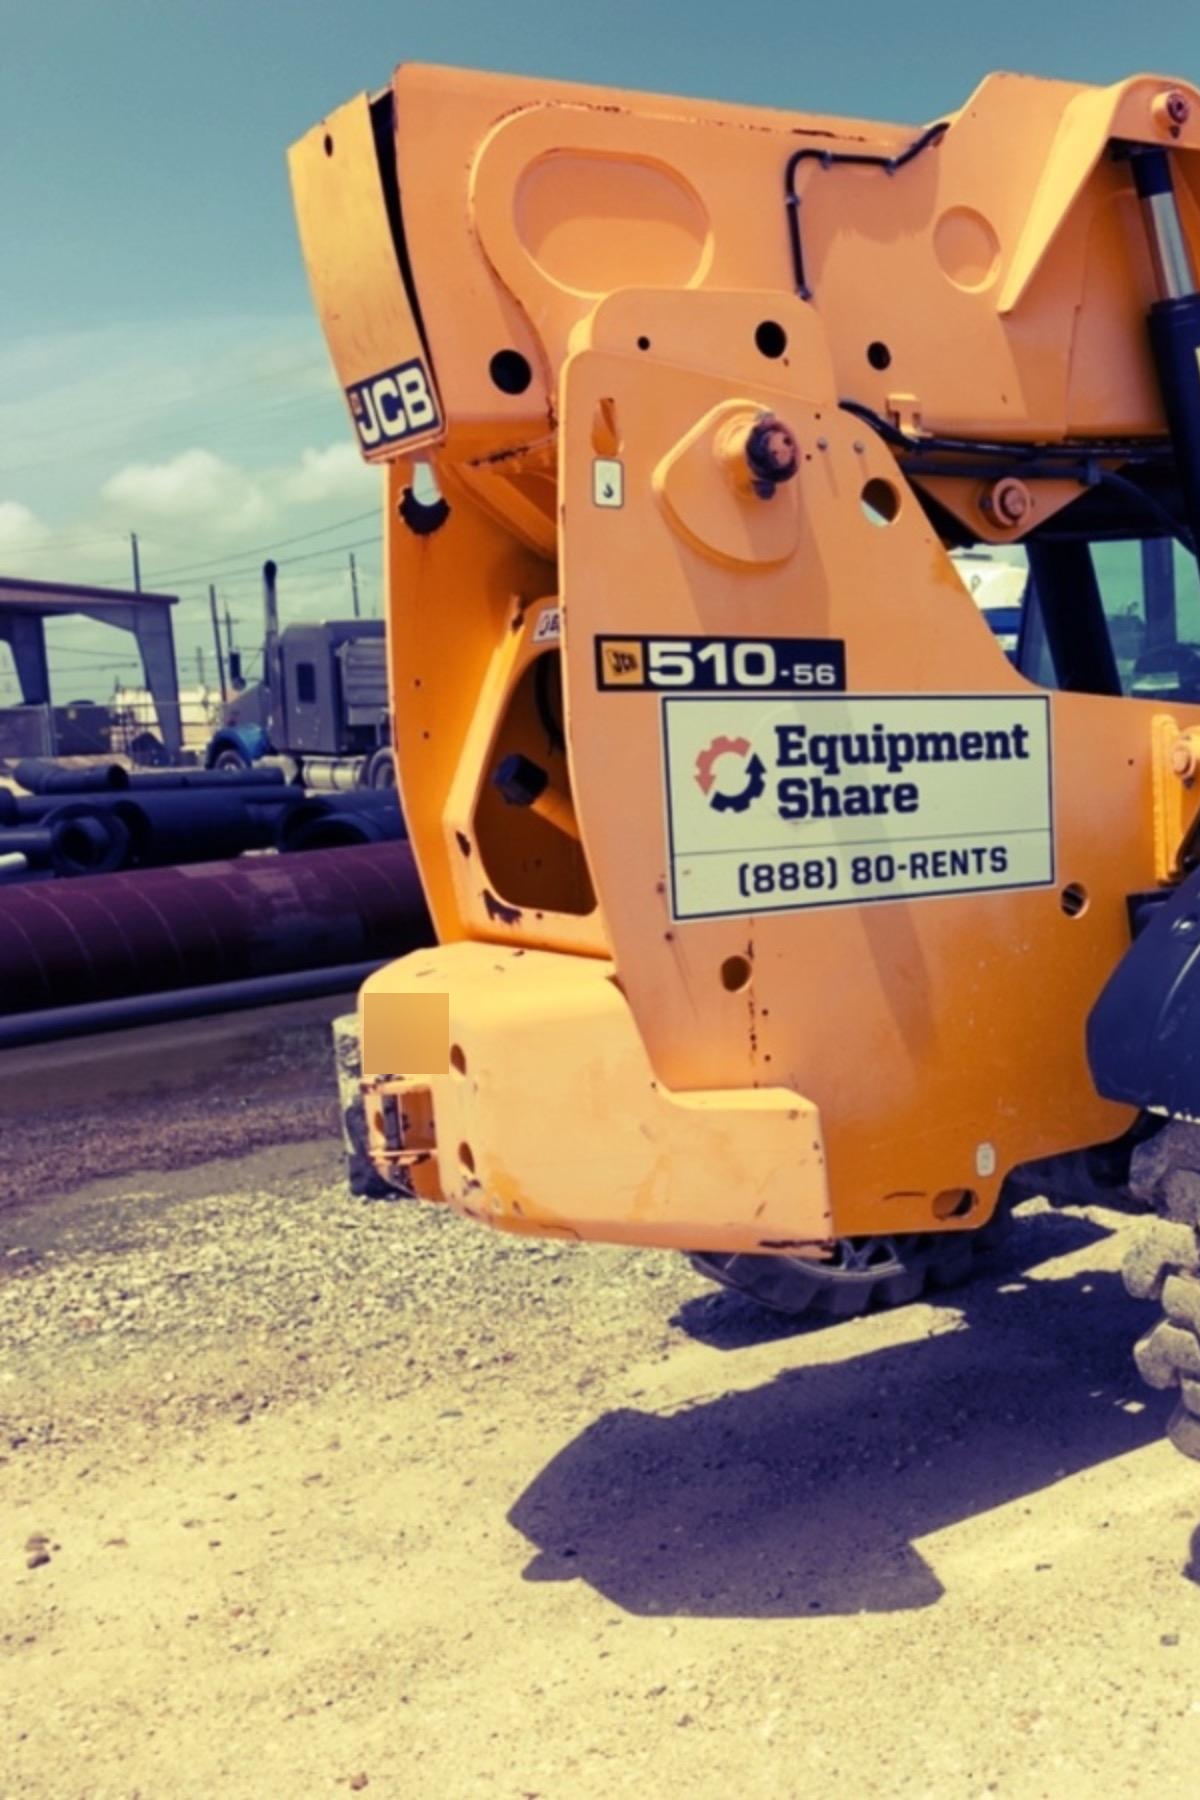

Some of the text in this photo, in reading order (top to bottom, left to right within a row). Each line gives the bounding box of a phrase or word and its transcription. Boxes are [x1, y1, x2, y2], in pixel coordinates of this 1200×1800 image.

[357, 366, 435, 444] JCB
[648, 642, 836, 685] 510-56
[774, 723, 1030, 775] Equipment
[776, 777, 920, 820] Share
[738, 846, 1009, 897] (888) 80-RENTS
